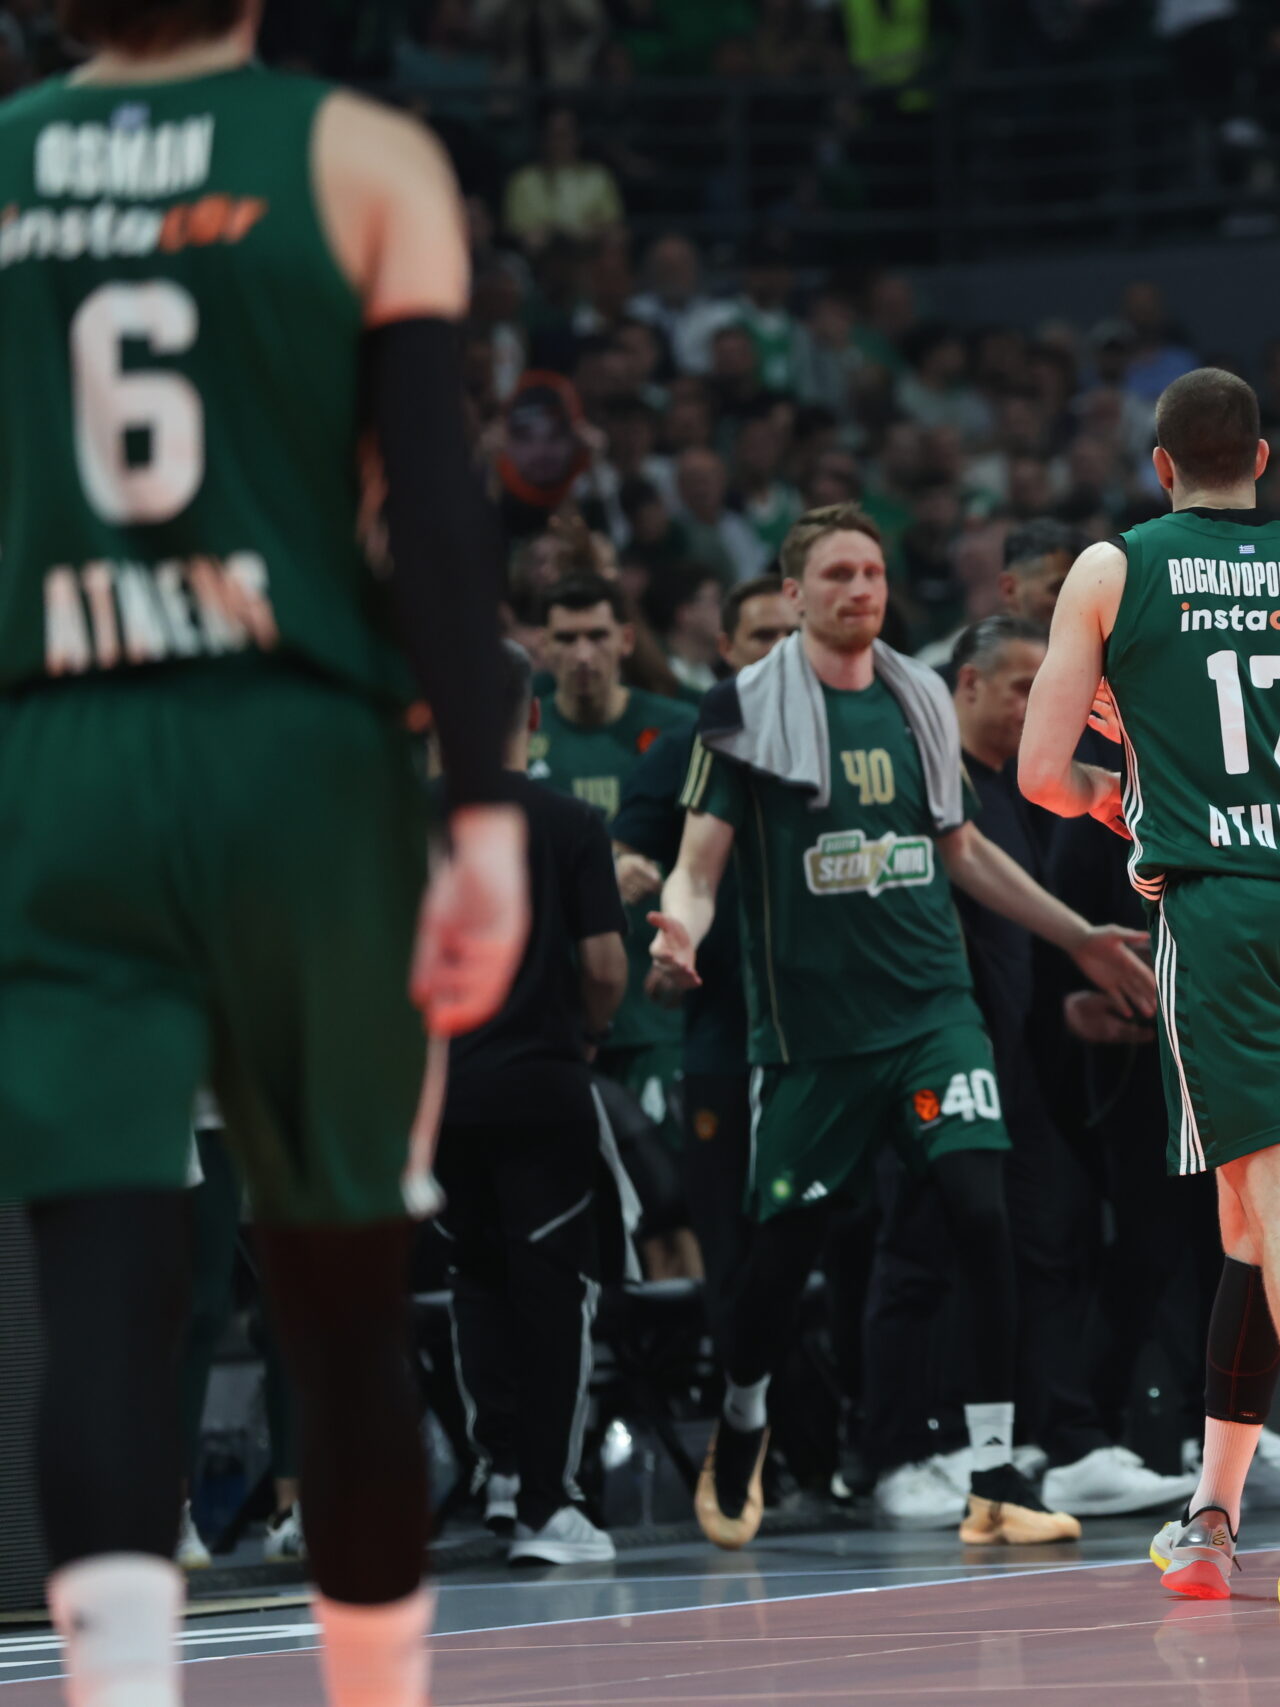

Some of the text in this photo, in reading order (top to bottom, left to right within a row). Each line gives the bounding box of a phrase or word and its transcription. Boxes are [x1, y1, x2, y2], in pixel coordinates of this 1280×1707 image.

[72, 279, 204, 526] 6
[44, 551, 279, 675] ATHENS
[841, 748, 895, 804] 40
[941, 1068, 1002, 1122] 40
